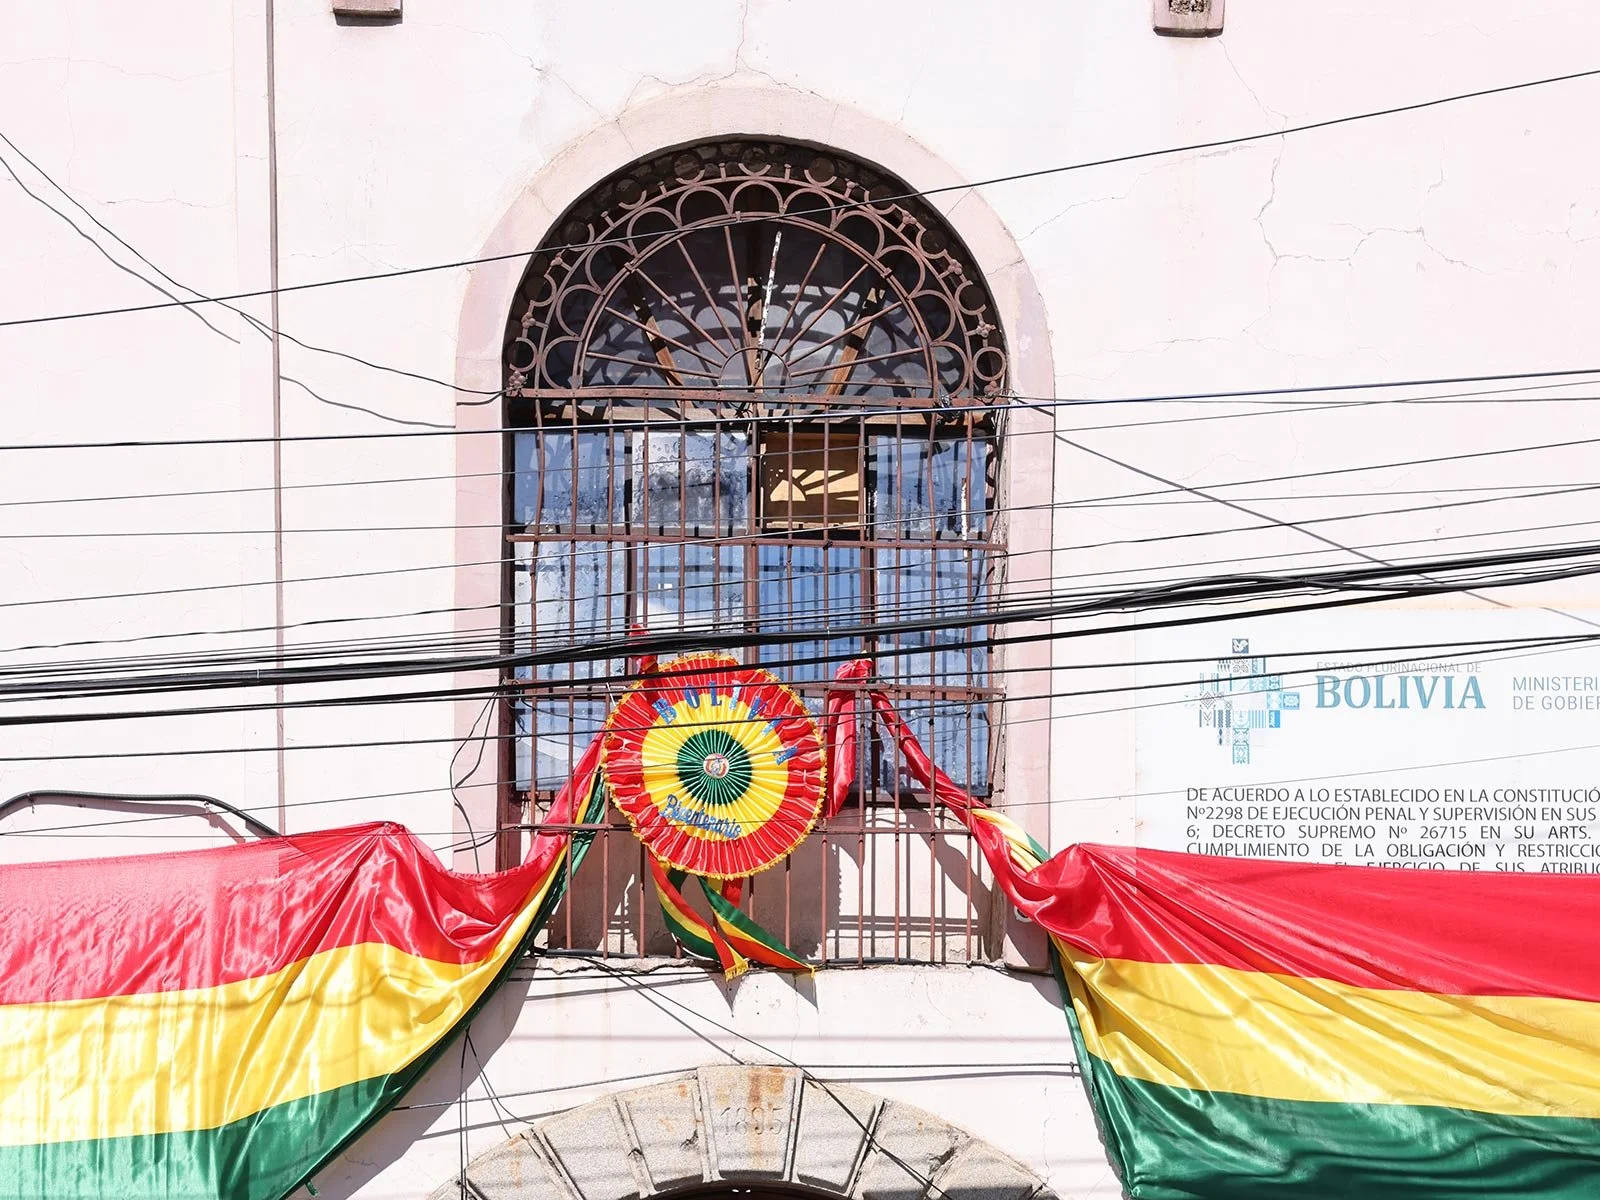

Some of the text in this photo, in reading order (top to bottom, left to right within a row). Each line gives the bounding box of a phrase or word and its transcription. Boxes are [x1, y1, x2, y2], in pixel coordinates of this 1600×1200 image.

[1316, 661, 1482, 673] ESTADO PLURINACIONAL DE
[1315, 675, 1487, 709] BOLIVIA
[1513, 695, 1535, 710] DE
[1187, 788, 1208, 802] DE
[1212, 788, 1290, 802] ACUERDO
[1294, 788, 1305, 802] A
[1310, 788, 1330, 802] LO
[1335, 788, 1440, 803] ESTABLECIDO
[1444, 789, 1464, 803] EN
[1470, 789, 1489, 803] LA
[1248, 806, 1269, 820] DE
[1273, 804, 1360, 820] EJECUCIÓN
[1366, 807, 1416, 821] PENAL
[1419, 807, 1429, 821] Y
[1433, 805, 1537, 821] SUPERVISIÓN
[1542, 807, 1562, 821] EN
[1567, 807, 1597, 821] SUS
[1186, 825, 1200, 840] 6;
[1213, 825, 1285, 839] DECRETO
[1298, 825, 1376, 839] SUPREMO
[1420, 826, 1467, 839] 26715
[1480, 826, 1501, 839] EN
[1514, 826, 1534, 839] SU
[1548, 826, 1591, 839] ARTS.
[1187, 842, 1309, 857] CUMPLIMIENTO
[1322, 843, 1343, 857] DE
[1355, 843, 1375, 857] LA
[1387, 841, 1485, 858] OBLIGACIÓN
[1495, 844, 1505, 857] Y
